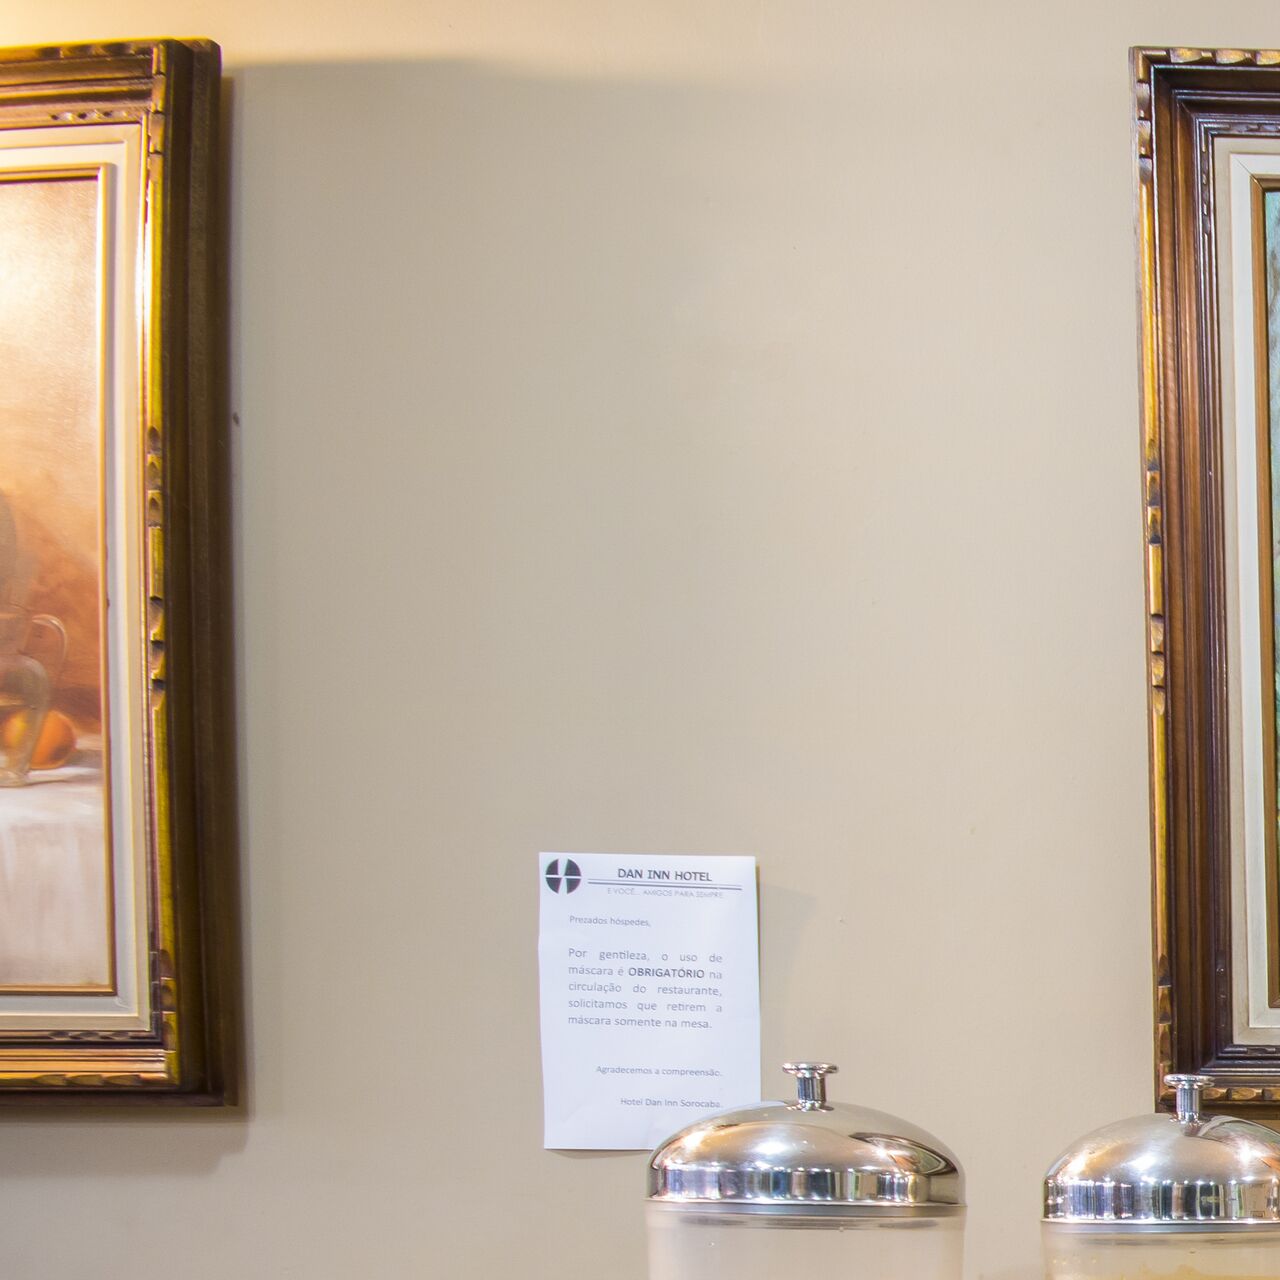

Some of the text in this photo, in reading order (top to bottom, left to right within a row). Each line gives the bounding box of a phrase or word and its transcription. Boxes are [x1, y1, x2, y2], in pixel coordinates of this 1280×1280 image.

[617, 868, 712, 881] DAN INN HOTEL
[569, 916, 608, 925] Prezados
[568, 948, 723, 963] Por gentileza, o uso de
[568, 965, 613, 975] máscara
[618, 967, 624, 976] é
[628, 967, 704, 978] OBRIGATÓRIO
[569, 982, 722, 997] circulação do restaurante,
[568, 999, 627, 1009] solicitamos
[637, 1003, 657, 1011] que
[667, 1002, 706, 1012] retirem
[568, 1015, 613, 1025] máscara
[614, 1017, 661, 1027] somente
[597, 1065, 652, 1074] Agradecemos
[621, 1098, 643, 1106] Hotel
[645, 1098, 662, 1107] Dan
[664, 1099, 678, 1107] Inn
